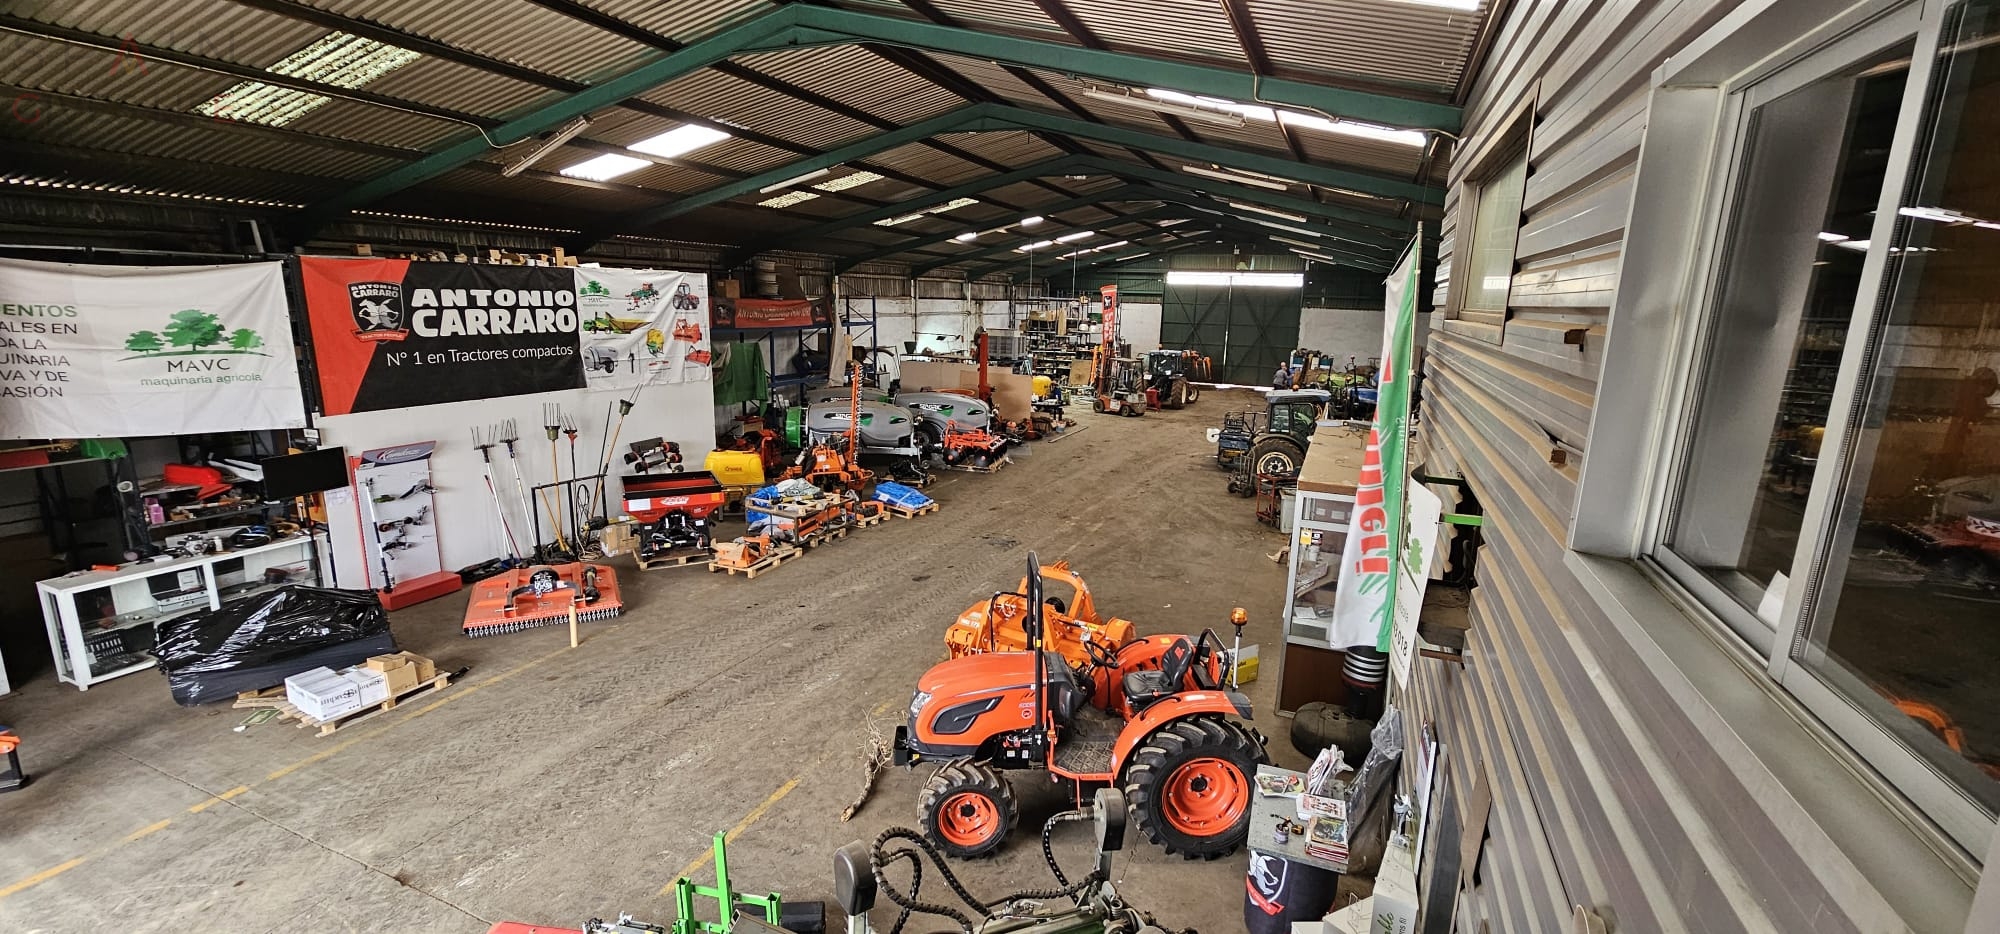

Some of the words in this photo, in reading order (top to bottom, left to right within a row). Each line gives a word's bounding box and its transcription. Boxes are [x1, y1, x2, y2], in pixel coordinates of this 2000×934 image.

[352, 289, 399, 298] CARRARO
[411, 288, 575, 308] ANTONIO
[51, 323, 78, 335] EN
[411, 308, 577, 338] CARRARO
[22, 338, 48, 350] LA
[413, 351, 423, 365] 1
[427, 352, 446, 365] en
[448, 347, 509, 363] Tractores
[512, 345, 574, 360] compactos
[167, 358, 231, 373] MAVC
[29, 370, 41, 381] Y
[44, 370, 70, 382] DE
[140, 375, 213, 388] maquinaria
[0, 384, 64, 398] ASIÓN
